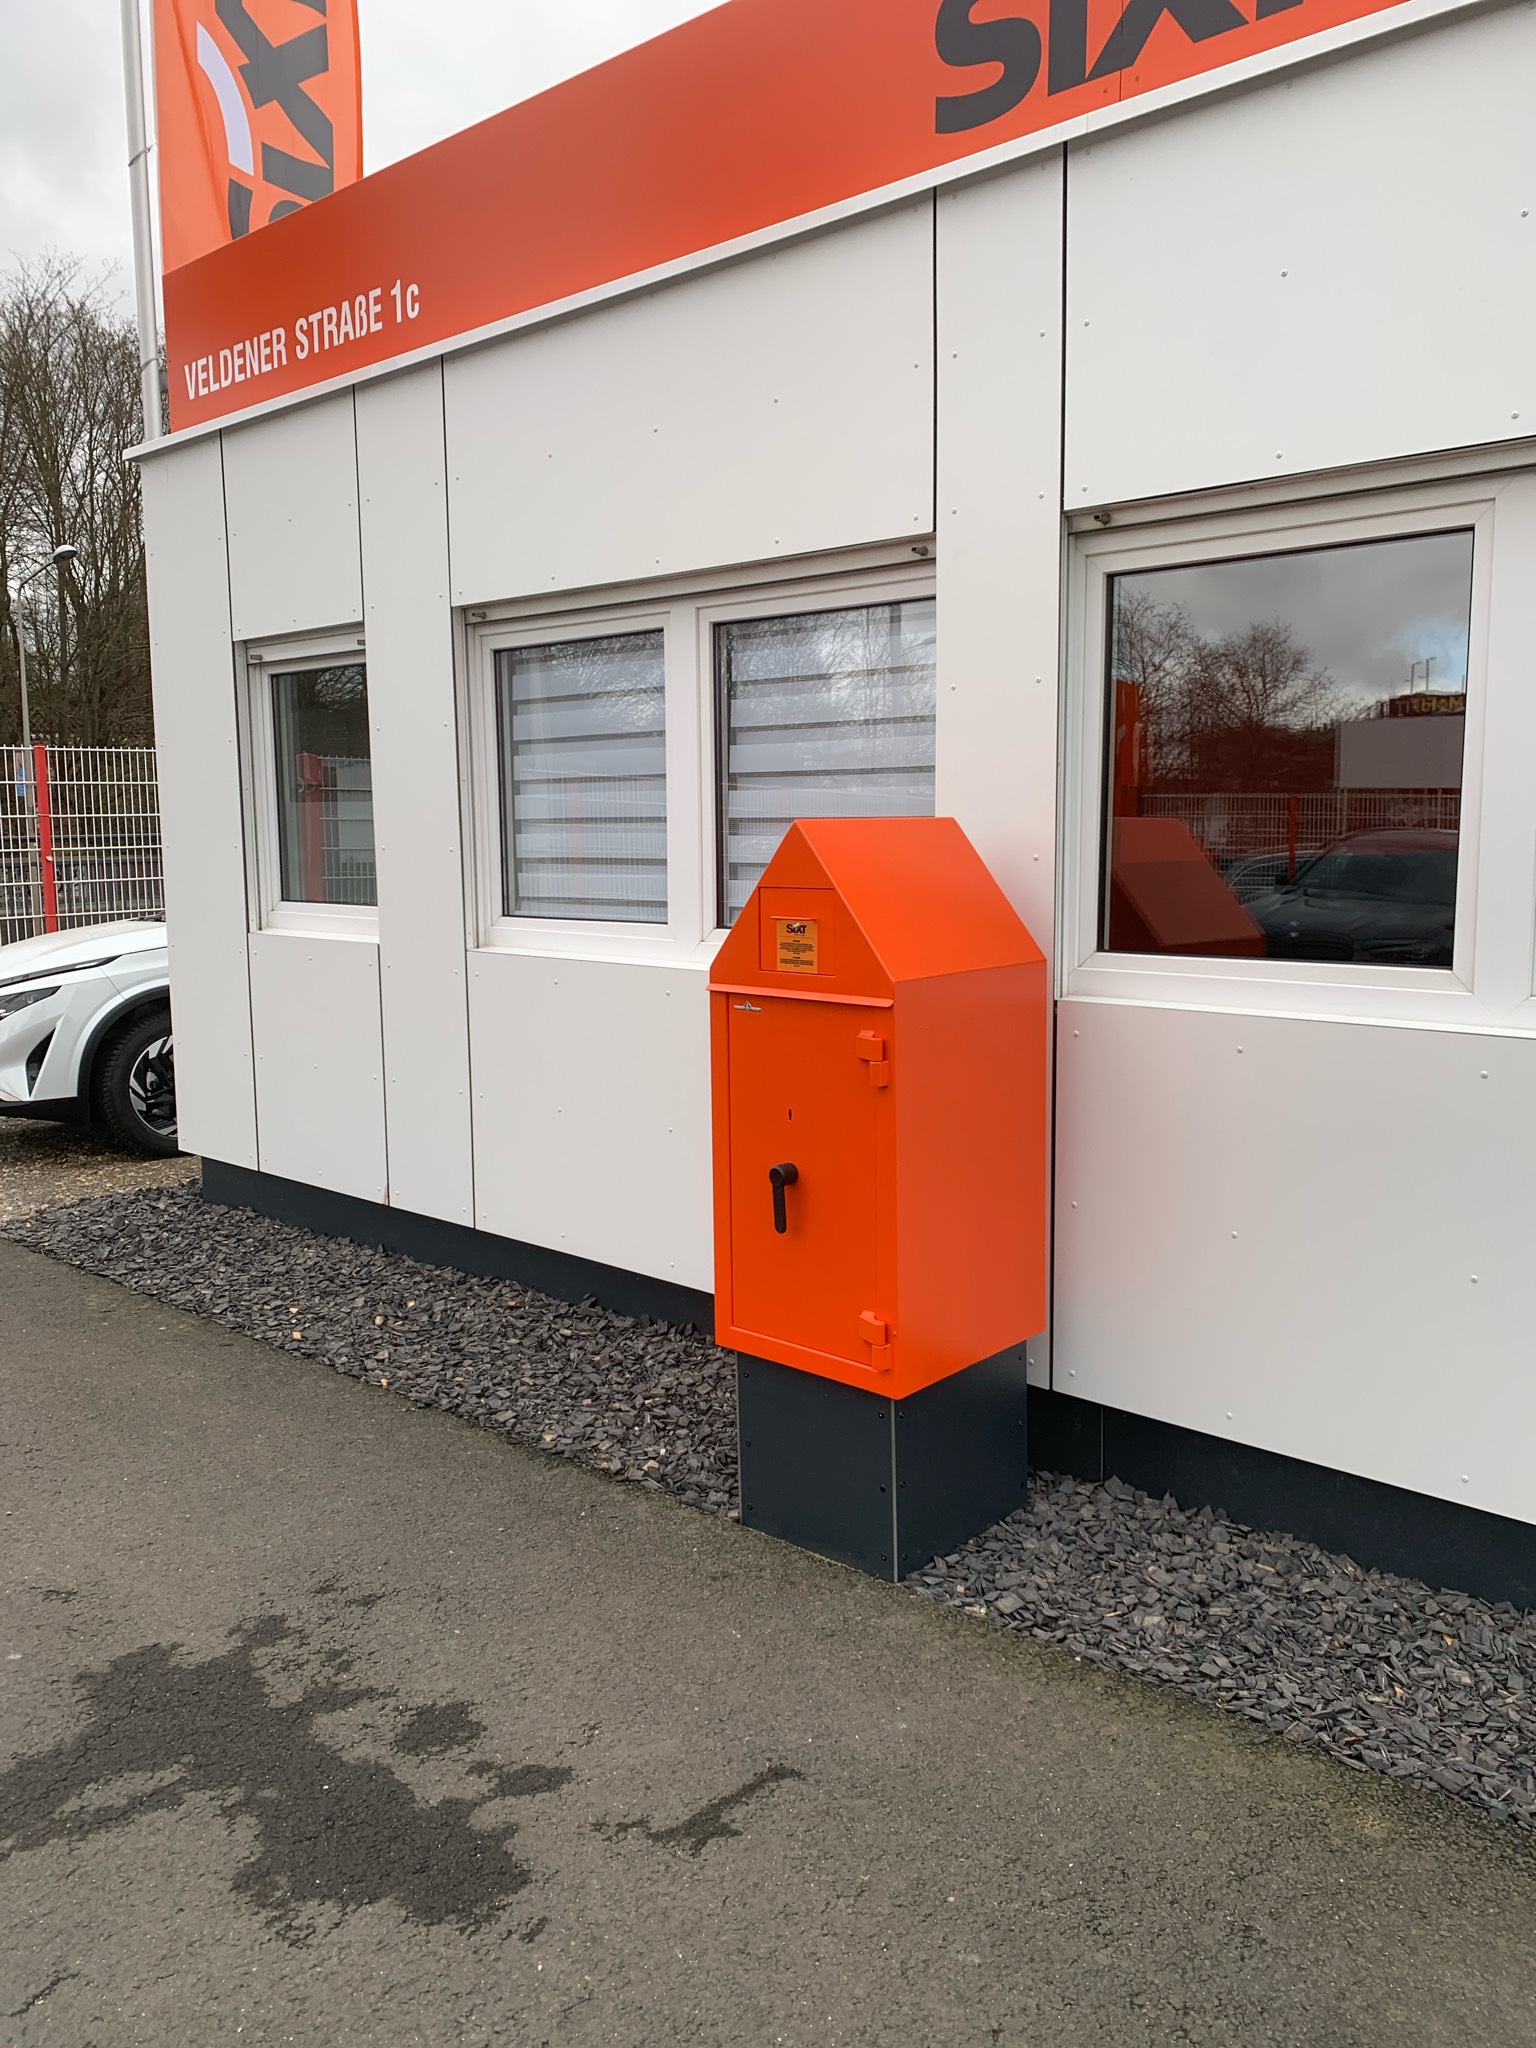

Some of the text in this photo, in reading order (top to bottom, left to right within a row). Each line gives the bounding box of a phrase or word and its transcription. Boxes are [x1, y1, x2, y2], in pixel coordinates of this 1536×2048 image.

[213, 0, 335, 241] IX
[935, 0, 1305, 135] SI
[184, 326, 288, 401] VELDENER
[295, 287, 383, 360] STRAßE
